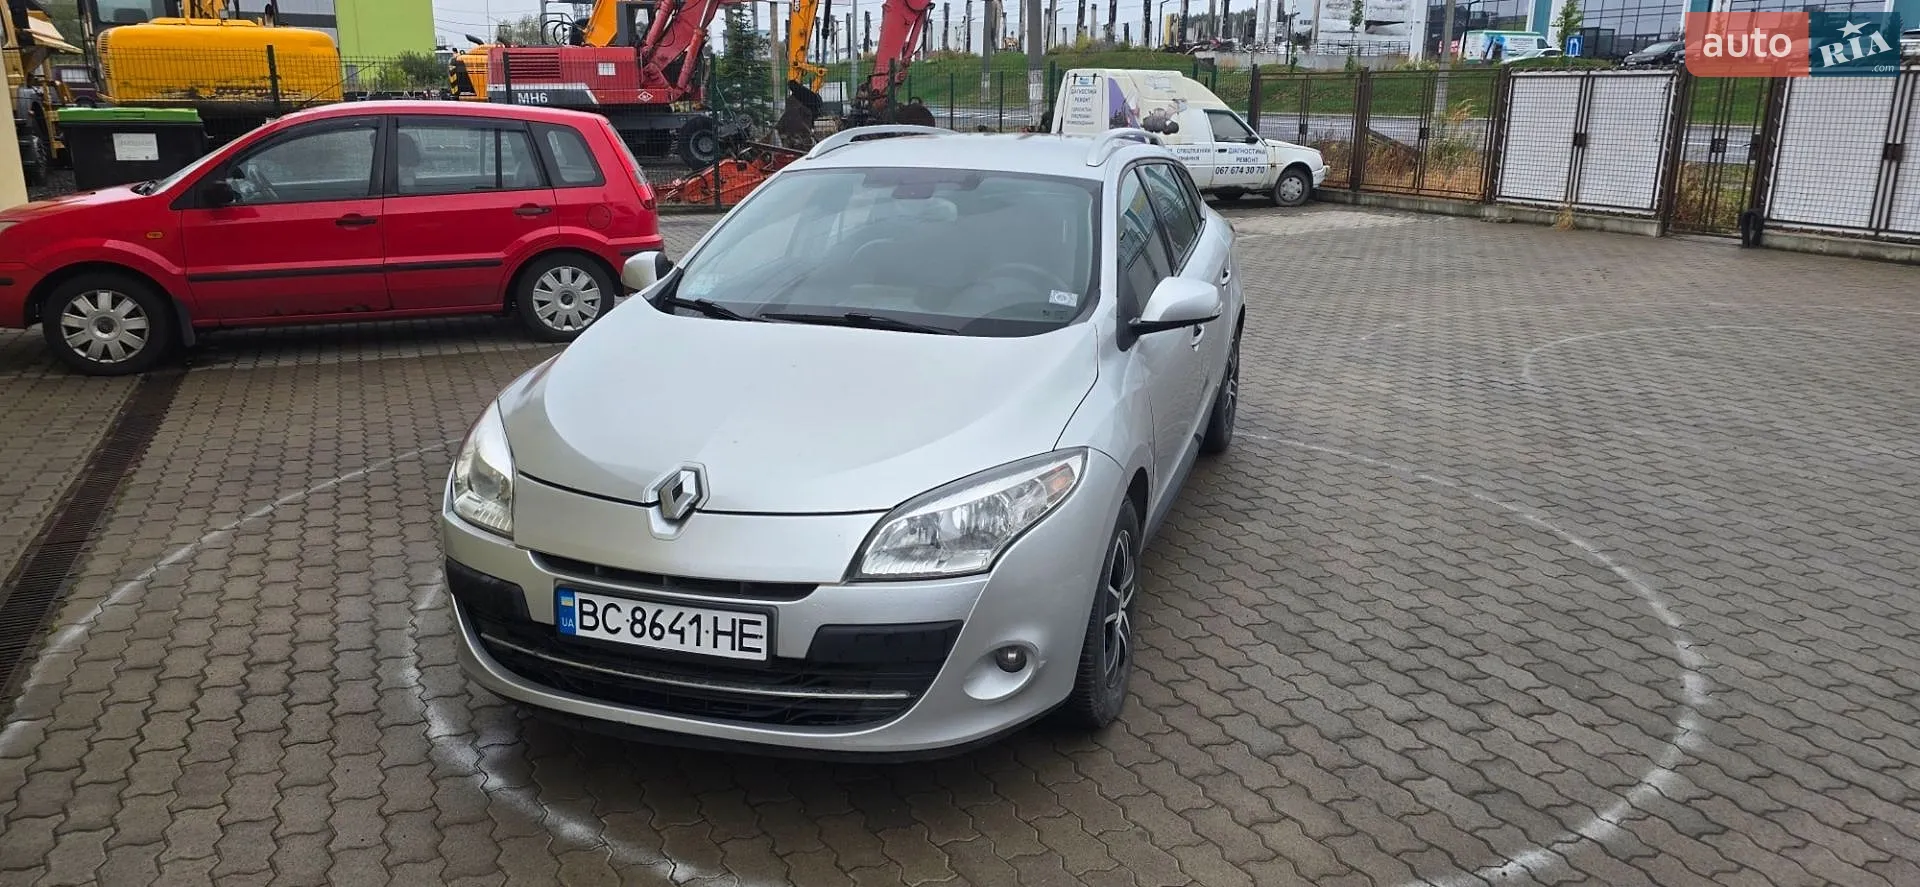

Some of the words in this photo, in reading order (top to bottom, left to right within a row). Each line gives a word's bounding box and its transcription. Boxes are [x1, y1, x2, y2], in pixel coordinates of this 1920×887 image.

[517, 92, 548, 104] MH6
[1215, 166, 1229, 175] 067
[1230, 166, 1244, 175] 674
[1245, 166, 1255, 174] 30
[1256, 166, 1265, 174] 70
[561, 617, 575, 628] UA
